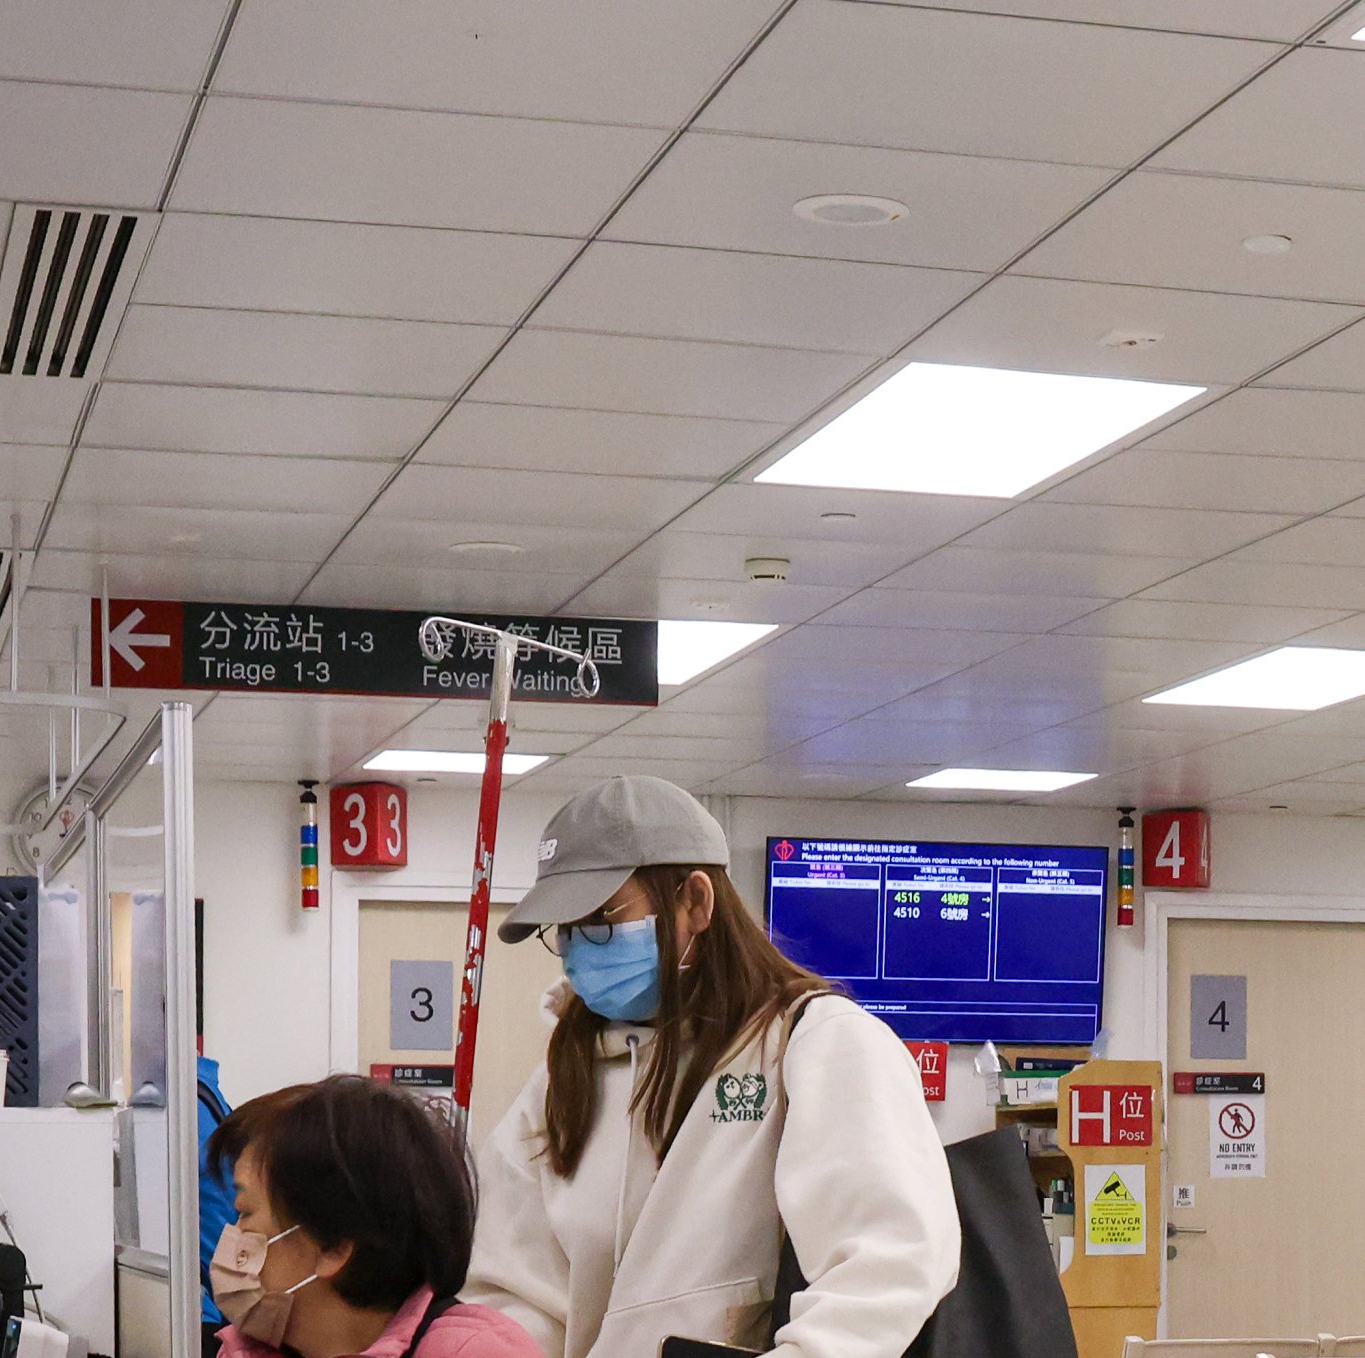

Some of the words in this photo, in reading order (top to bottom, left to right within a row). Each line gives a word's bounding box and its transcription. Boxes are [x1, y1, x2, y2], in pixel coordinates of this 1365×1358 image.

[200, 611, 323, 653] 分流站
[338, 631, 374, 653] 1-3
[198, 656, 276, 686] Triage
[293, 661, 330, 683] 1-3
[423, 666, 489, 688] Fever
[511, 670, 584, 698] aiting
[343, 793, 367, 856] 3
[387, 794, 401, 857] 3
[801, 853, 823, 862] Please
[824, 854, 841, 862] enter
[842, 853, 853, 862] the
[854, 854, 890, 864] designated
[891, 855, 930, 864] consultation
[932, 857, 950, 865] room
[951, 857, 982, 867] according
[984, 858, 991, 866] to
[992, 858, 1003, 866] the
[1004, 858, 1033, 868] following
[1034, 859, 1060, 868] number
[1155, 821, 1185, 879] 4
[893, 892, 921, 903] 4516
[893, 907, 920, 919] 4510
[410, 987, 434, 1022] 3
[1208, 1000, 1230, 1033] 4
[916, 1049, 939, 1074] 位
[923, 1086, 939, 1096] ost
[1016, 1080, 1028, 1099] H
[1252, 1076, 1262, 1091] 4
[1071, 1090, 1110, 1143] H
[1119, 1091, 1144, 1119] 位
[1119, 1129, 1145, 1141] Post
[1219, 1143, 1230, 1153] NO
[1232, 1143, 1256, 1153] ENTRY
[1178, 1187, 1190, 1199] 推
